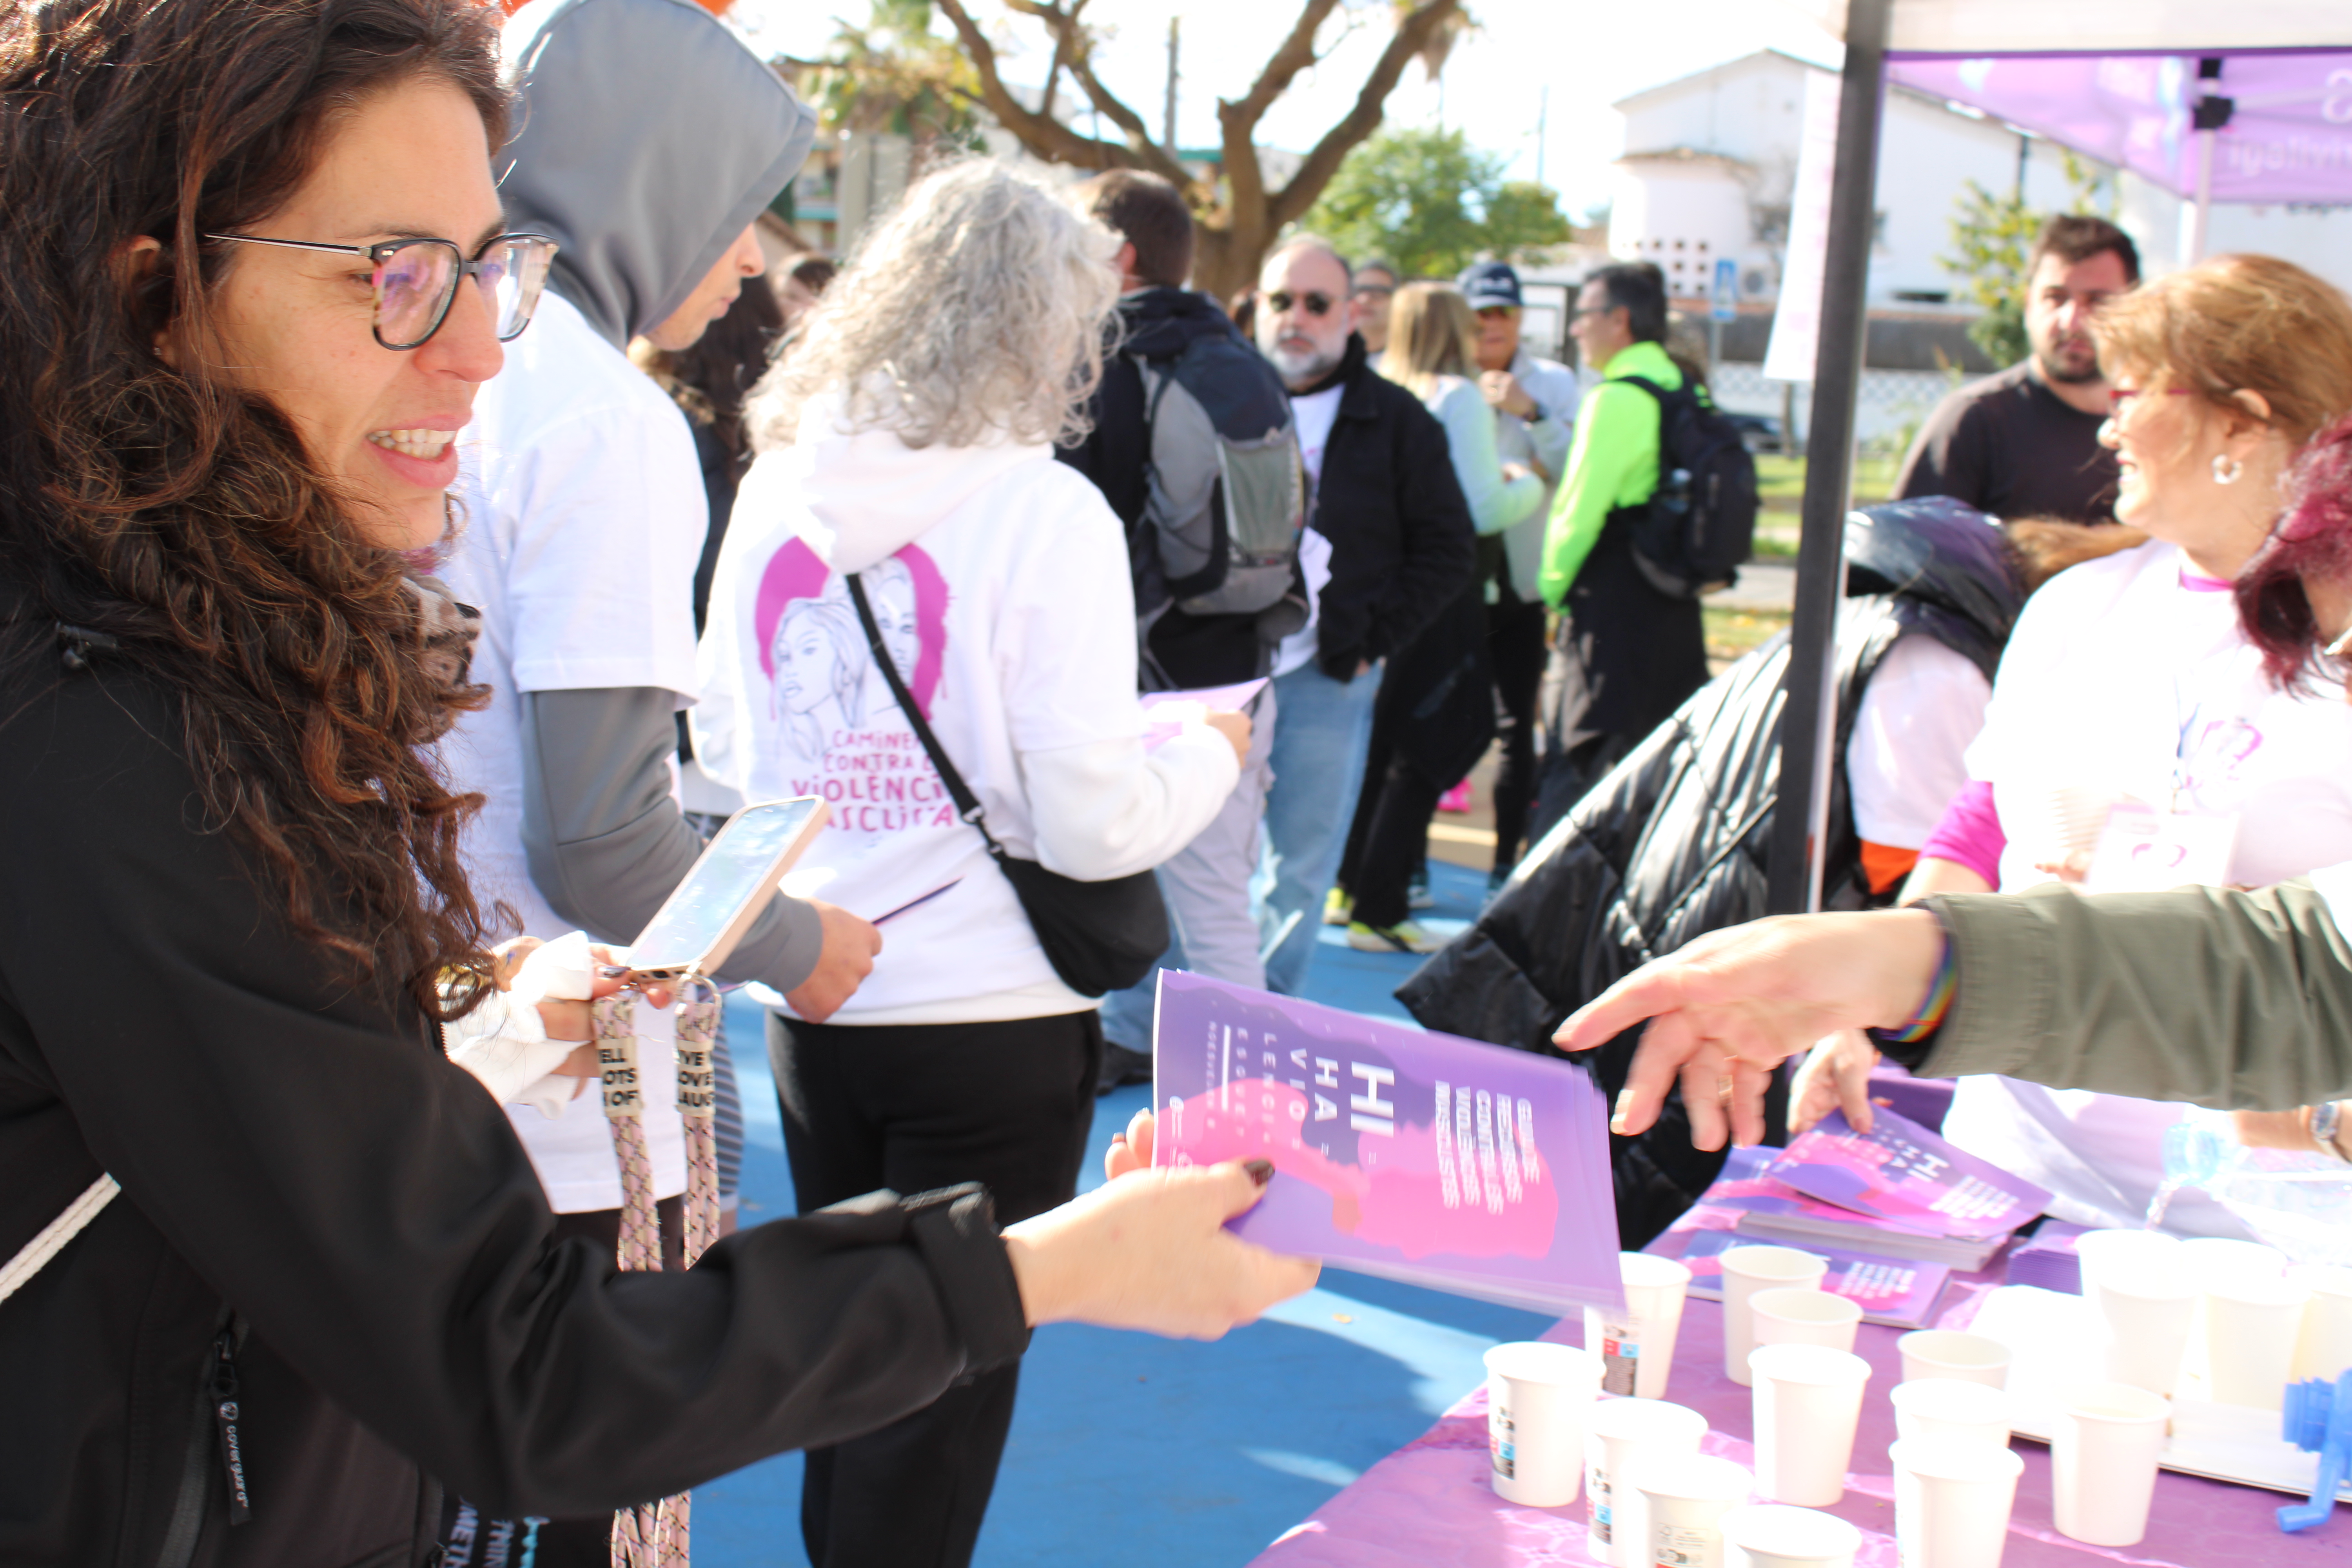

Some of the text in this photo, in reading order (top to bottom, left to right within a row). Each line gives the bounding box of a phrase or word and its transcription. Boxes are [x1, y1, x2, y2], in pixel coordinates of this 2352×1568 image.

[823, 753, 914, 772] CONTRA
[1315, 1056, 1339, 1122] HA
[1351, 1060, 1395, 1138] HI
